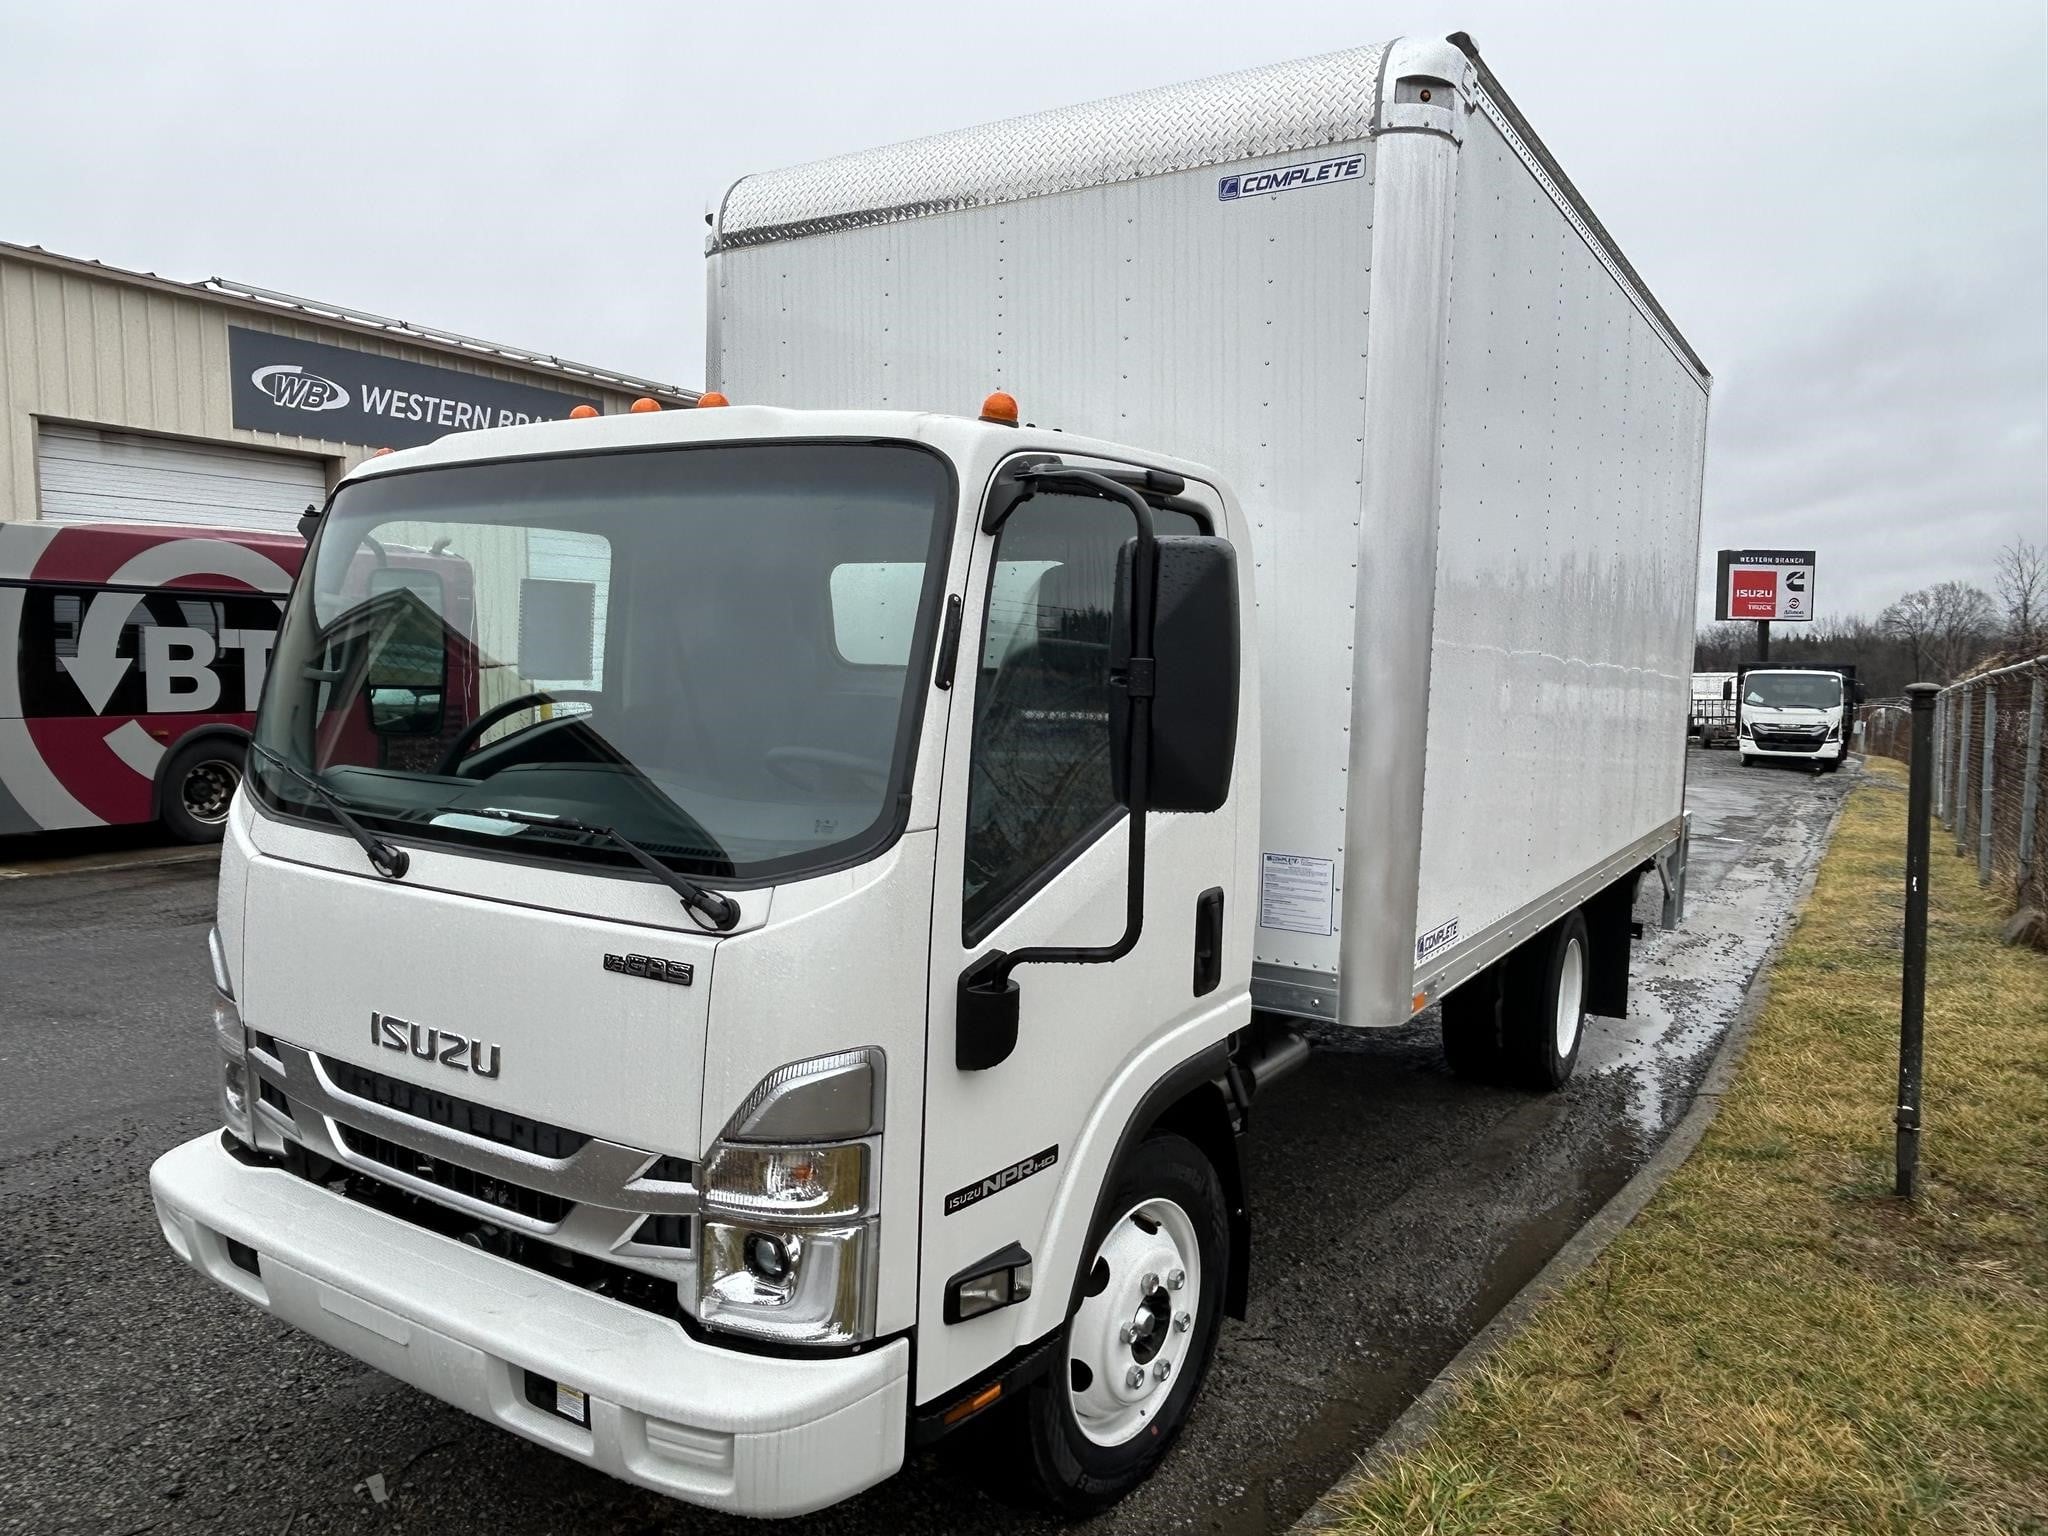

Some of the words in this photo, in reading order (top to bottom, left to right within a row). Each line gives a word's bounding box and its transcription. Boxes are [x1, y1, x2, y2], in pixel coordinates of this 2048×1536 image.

[1242, 158, 1362, 194] COMPLETE
[273, 373, 330, 411] WB
[361, 384, 491, 430] WESTERN
[1740, 556, 1773, 564] WESTERN
[1736, 589, 1773, 598] ISUZU
[370, 1010, 501, 1080] ISUZU
[949, 1187, 981, 1209] ISUZU
